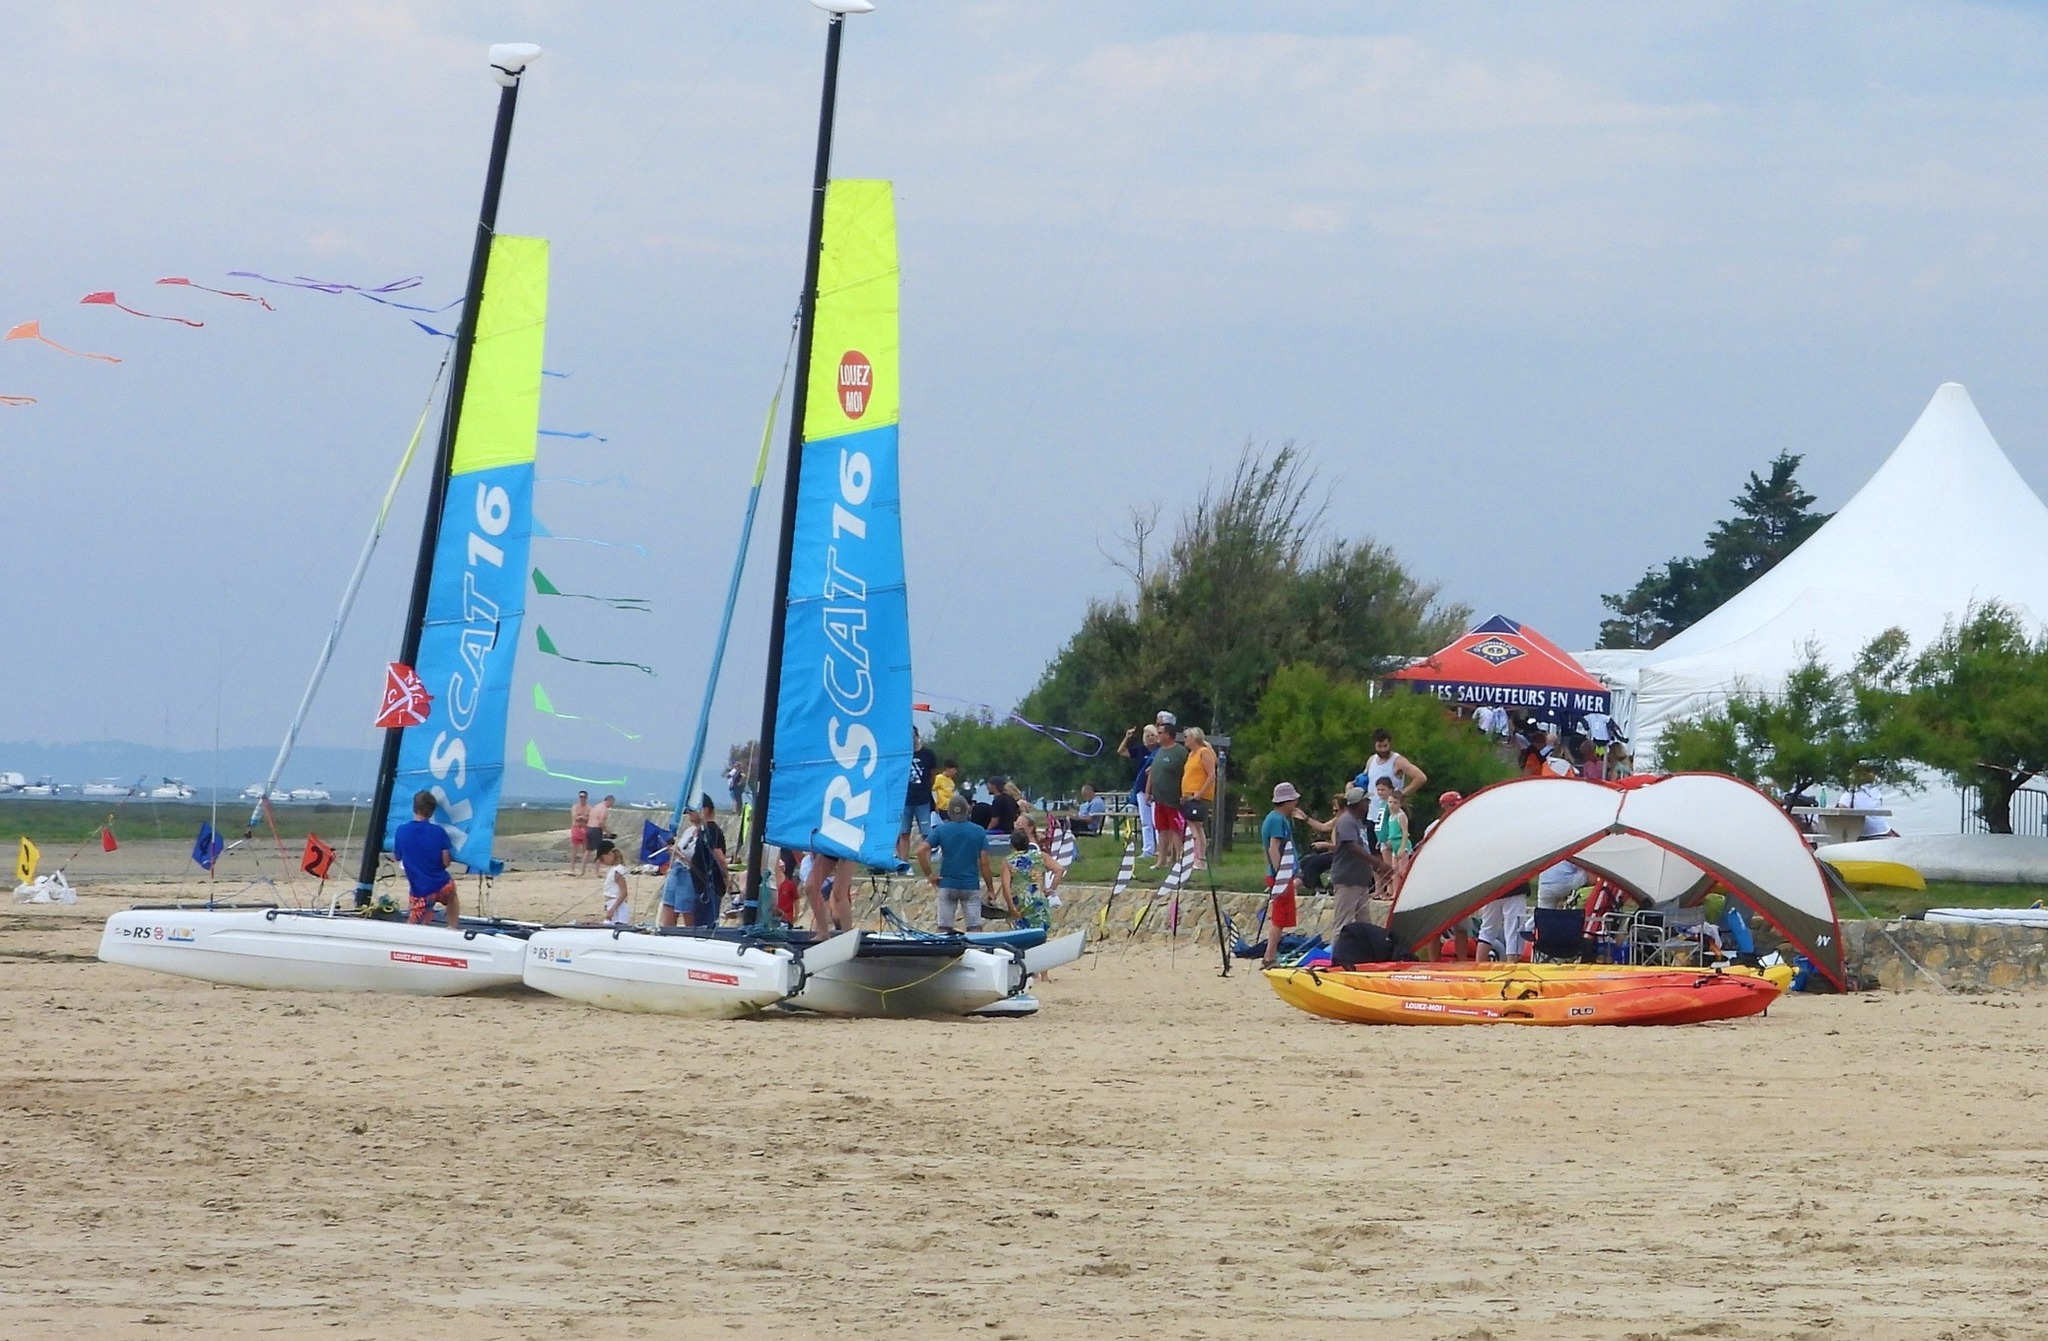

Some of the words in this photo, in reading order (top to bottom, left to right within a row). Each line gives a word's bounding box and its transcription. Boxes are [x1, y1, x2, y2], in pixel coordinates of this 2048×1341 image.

[840, 364, 871, 386] LOUEZ
[845, 391, 863, 412] MOI
[1457, 685, 1546, 706] SAUVETEURS
[1549, 691, 1568, 708] EN
[1573, 693, 1604, 713] MER
[132, 926, 152, 939] RS
